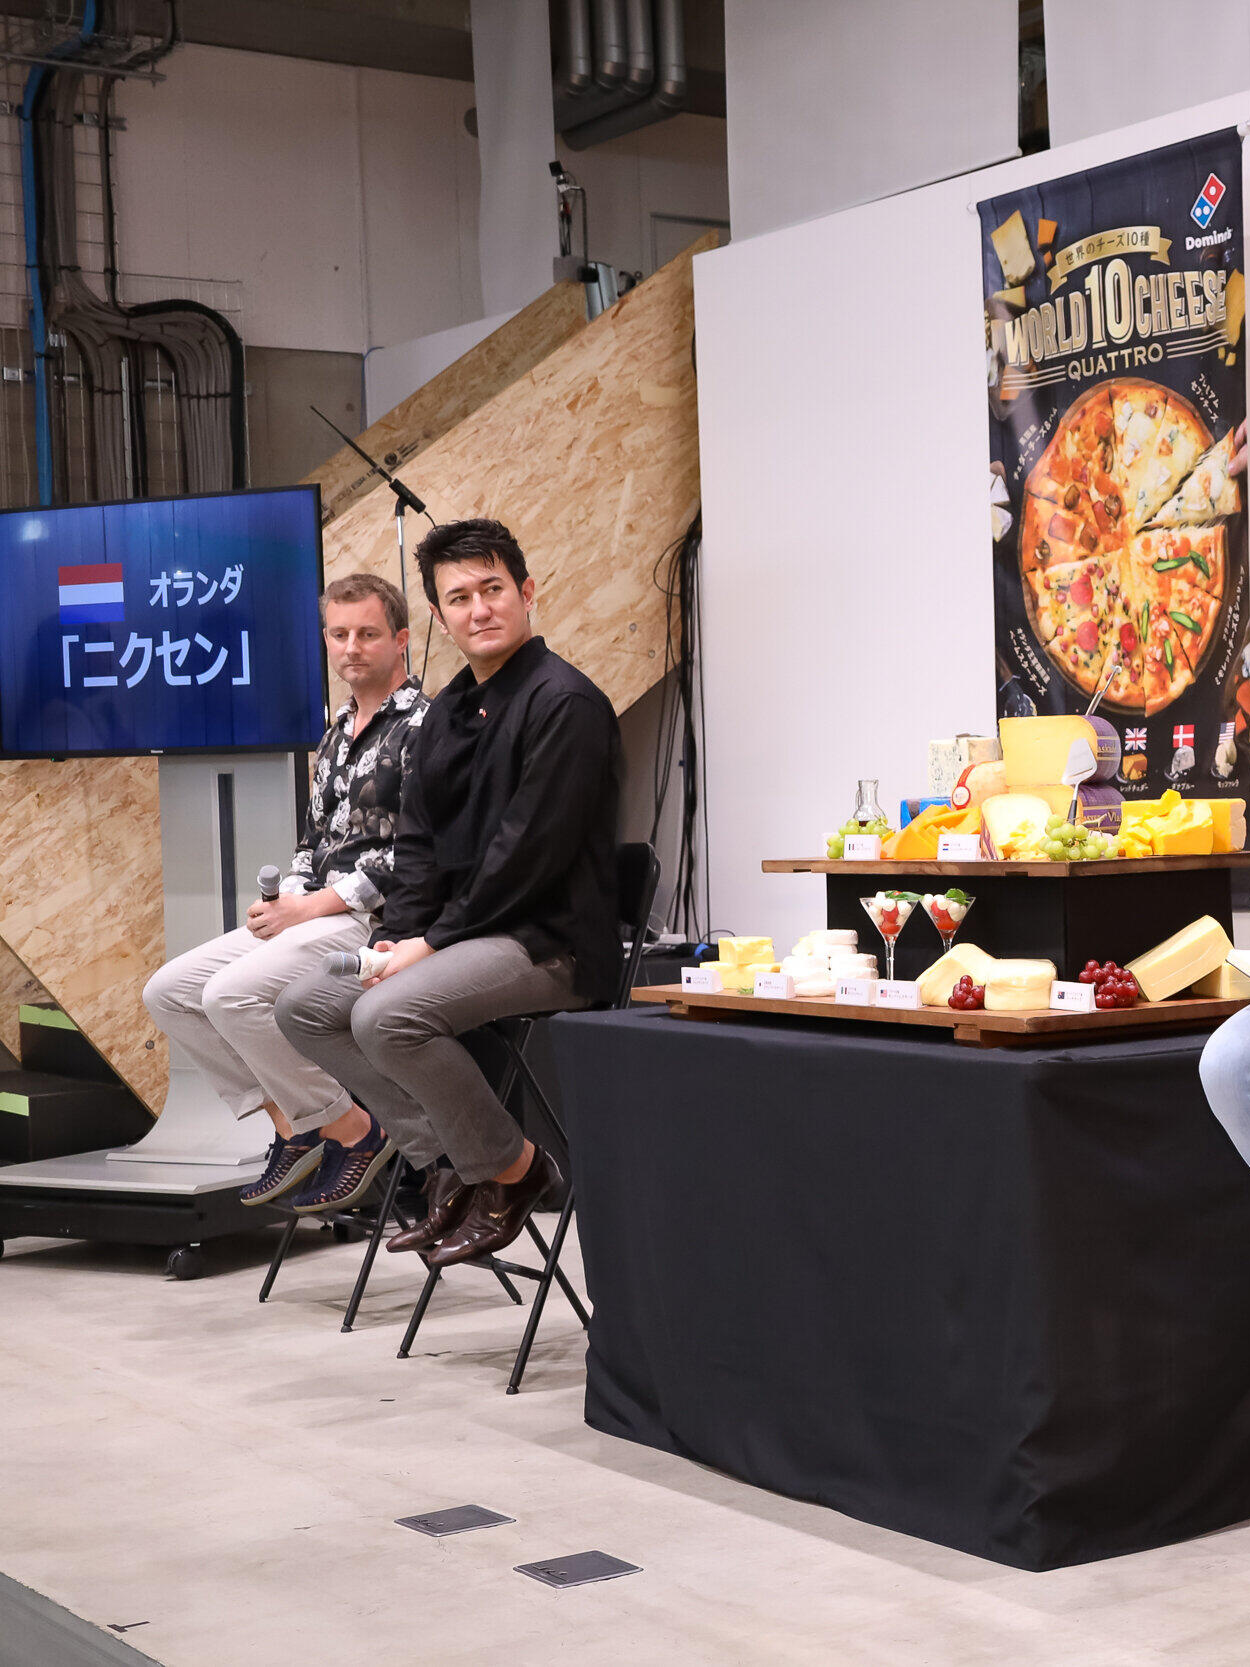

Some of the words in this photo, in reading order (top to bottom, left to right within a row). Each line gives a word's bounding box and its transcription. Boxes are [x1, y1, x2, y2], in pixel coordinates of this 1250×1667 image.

[1004, 291, 1089, 367] WORLD
[1084, 258, 1135, 350] 10
[1134, 269, 1227, 339] CHEESE
[1067, 342, 1164, 382] QUATTRO
[149, 563, 244, 608] オランダ
[62, 630, 251, 689] 「ニクセン」
